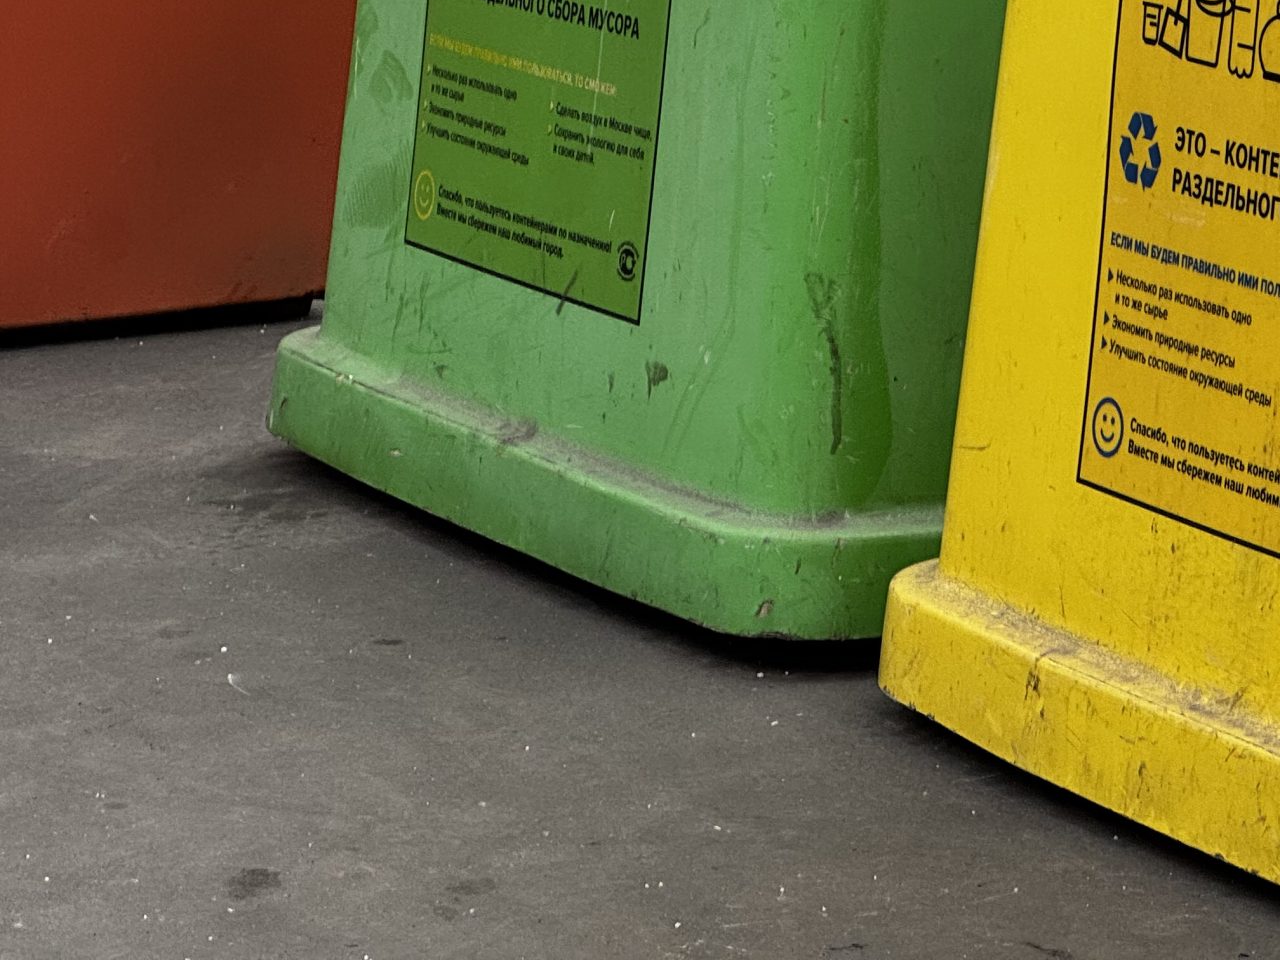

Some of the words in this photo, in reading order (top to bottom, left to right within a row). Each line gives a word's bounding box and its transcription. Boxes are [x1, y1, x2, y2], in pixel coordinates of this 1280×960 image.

[589, 6, 639, 40] МУСОРА
[1174, 126, 1207, 159] ЭТО
[1110, 231, 1133, 252] ЕСЛИ
[1134, 239, 1150, 258] МЫ
[1150, 244, 1180, 266] БУДЕМ
[1181, 254, 1236, 284] ПРАВИЛЬНО
[1238, 271, 1259, 292] ИМИ
[1115, 293, 1121, 305] и
[1121, 294, 1130, 307] то
[1131, 298, 1143, 312] же
[1144, 302, 1169, 321] сырье
[1116, 269, 1158, 297] Несколько
[1159, 286, 1173, 302] раз
[1174, 289, 1230, 320] использовать
[1231, 309, 1253, 326] одно
[1112, 314, 1154, 342] Экономить
[1155, 331, 1200, 356] природные
[1201, 346, 1236, 369] ресурсы
[1109, 339, 1147, 365] Улучшить
[1147, 355, 1189, 379] состояние
[1189, 369, 1244, 399] окружающей
[1245, 387, 1272, 408] среды
[1128, 438, 1159, 464] Вместе
[1160, 453, 1176, 470] мы
[1176, 459, 1223, 486] сбережем
[1224, 476, 1245, 495] наш
[1130, 417, 1169, 447] Спасибо,
[1171, 436, 1186, 451] что
[1188, 440, 1245, 473] пользуетесь
